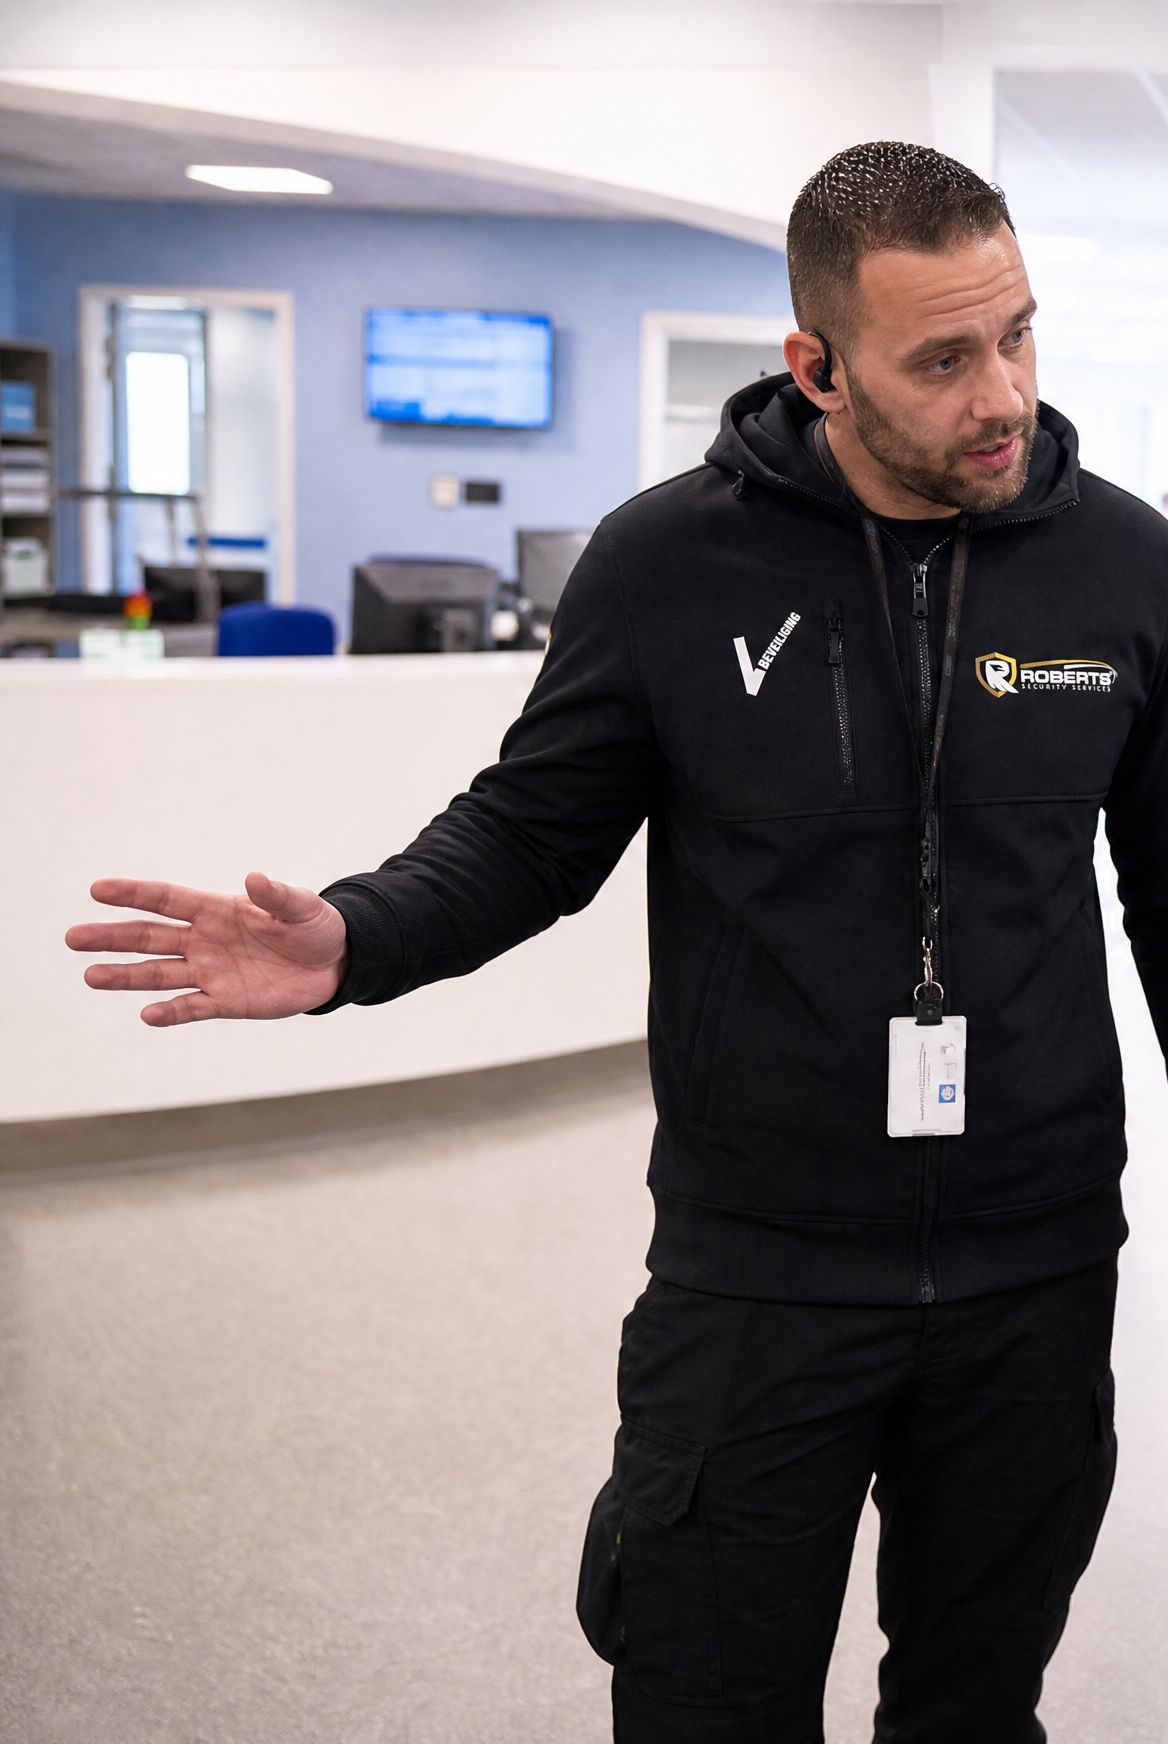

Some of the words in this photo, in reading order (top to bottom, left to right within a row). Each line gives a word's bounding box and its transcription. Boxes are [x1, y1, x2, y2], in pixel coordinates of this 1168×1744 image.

[757, 611, 801, 670] BEVEILIGING
[1020, 669, 1112, 686] ROBERTS
[1072, 684, 1111, 692] SERVICES
